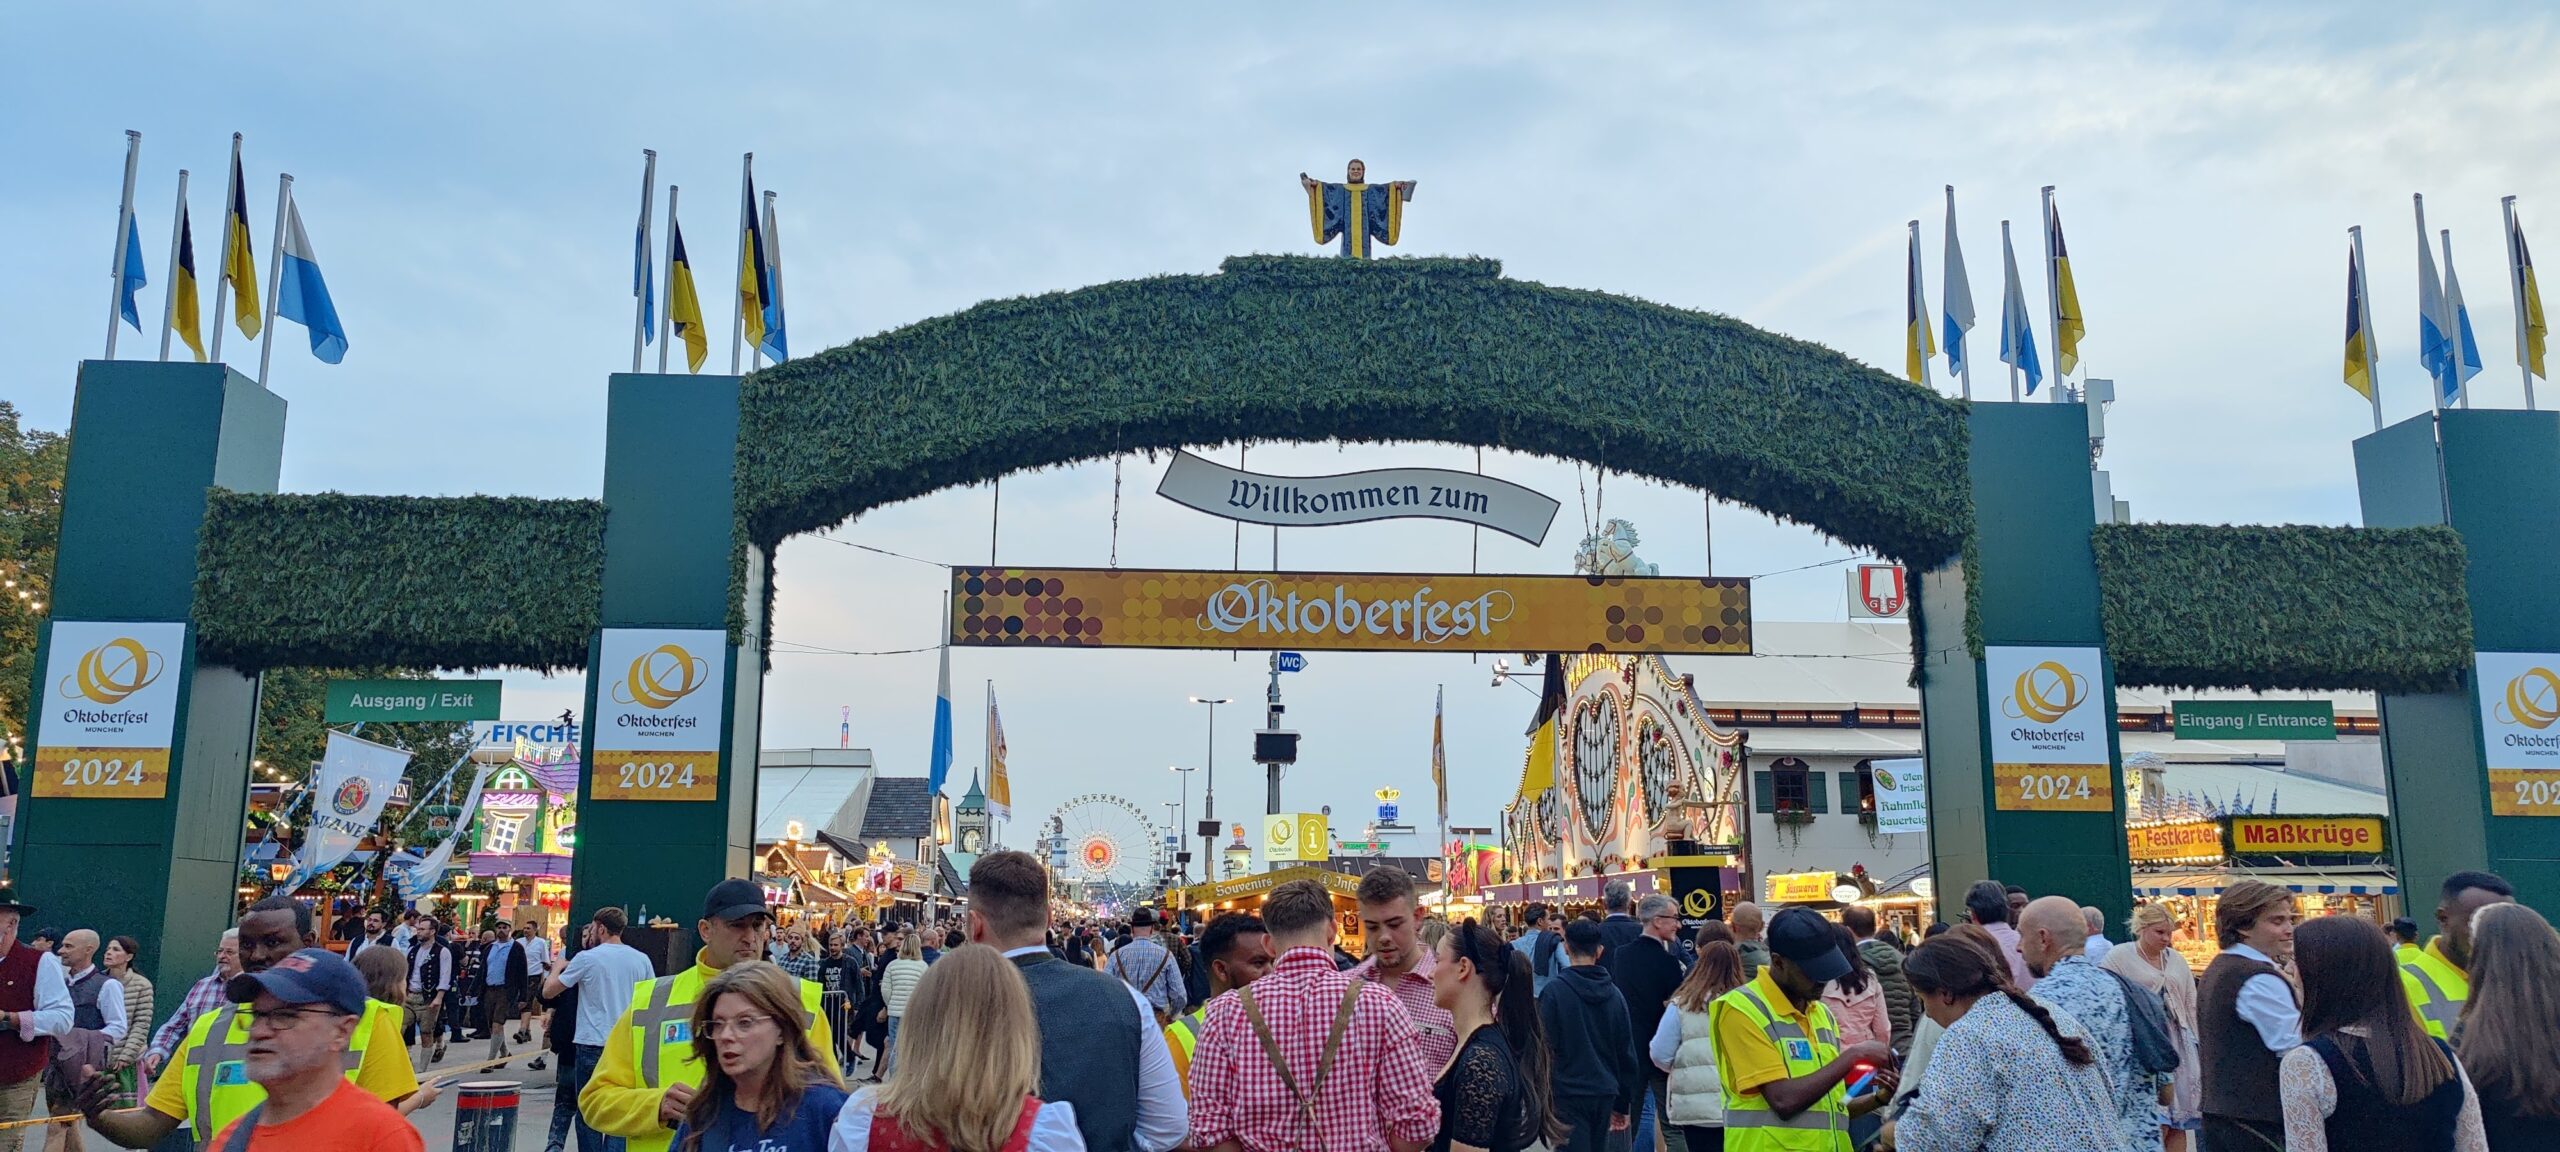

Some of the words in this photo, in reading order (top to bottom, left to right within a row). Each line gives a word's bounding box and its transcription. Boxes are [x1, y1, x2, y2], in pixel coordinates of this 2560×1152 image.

[1228, 479, 1419, 515] Willkommen
[1428, 486, 1489, 514] zum
[1196, 578, 1515, 644] Oktoberfest
[1870, 600, 1878, 608] G
[1889, 600, 1897, 608] S
[1281, 656, 1300, 668] WC
[350, 694, 426, 711] Ausgang
[431, 693, 437, 707] /
[441, 694, 474, 707] Exit
[63, 709, 149, 725] Oktoberfest
[617, 714, 697, 729] Oktoberfest
[2180, 714, 2244, 730] Eingang
[2248, 714, 2253, 727] /
[2257, 714, 2327, 727] Entrance
[492, 724, 579, 743] FISCHE
[2011, 728, 2084, 743] Oktoberfest
[2504, 734, 2560, 749] Oktoberf
[62, 758, 144, 786] 2024
[619, 762, 695, 789] 2024
[2020, 775, 2091, 800] 2024
[2514, 780, 2560, 805] 202
[1881, 800, 1927, 811] Rahmfle
[2244, 824, 2369, 846] Maßkrüge
[1215, 877, 1272, 897] Souvenirs
[1333, 876, 1359, 892] Info
